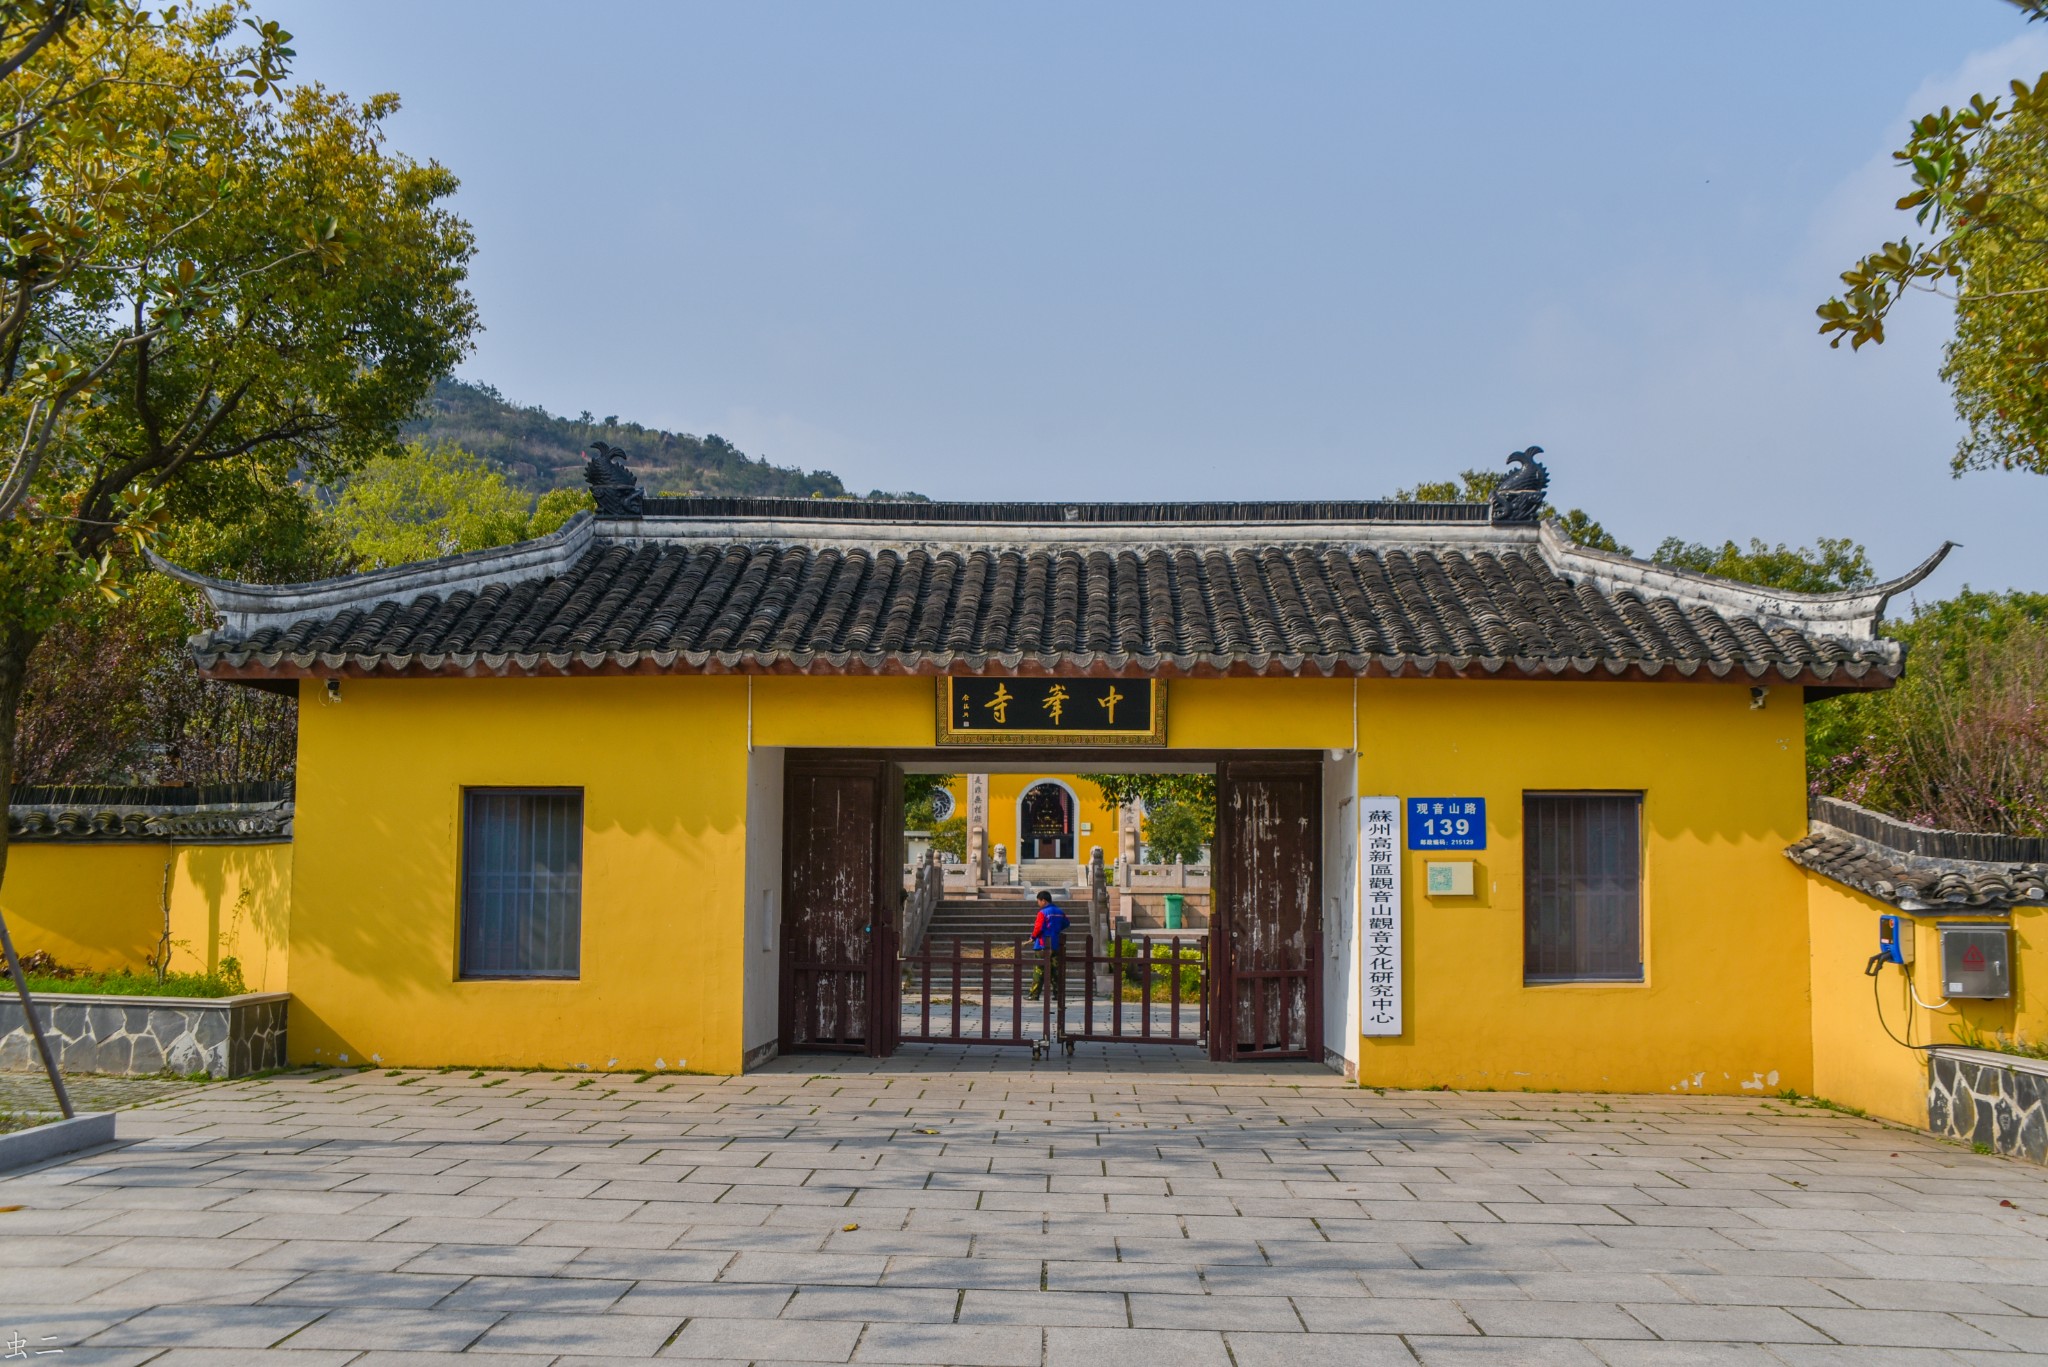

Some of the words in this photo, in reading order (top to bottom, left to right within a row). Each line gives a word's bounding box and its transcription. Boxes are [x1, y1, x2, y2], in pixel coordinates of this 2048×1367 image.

[1416, 803, 1476, 815] 观音山路
[1424, 818, 1470, 836] 139
[1368, 810, 1394, 1024] 蘇州高新區觀音山觀音文化研究中心
